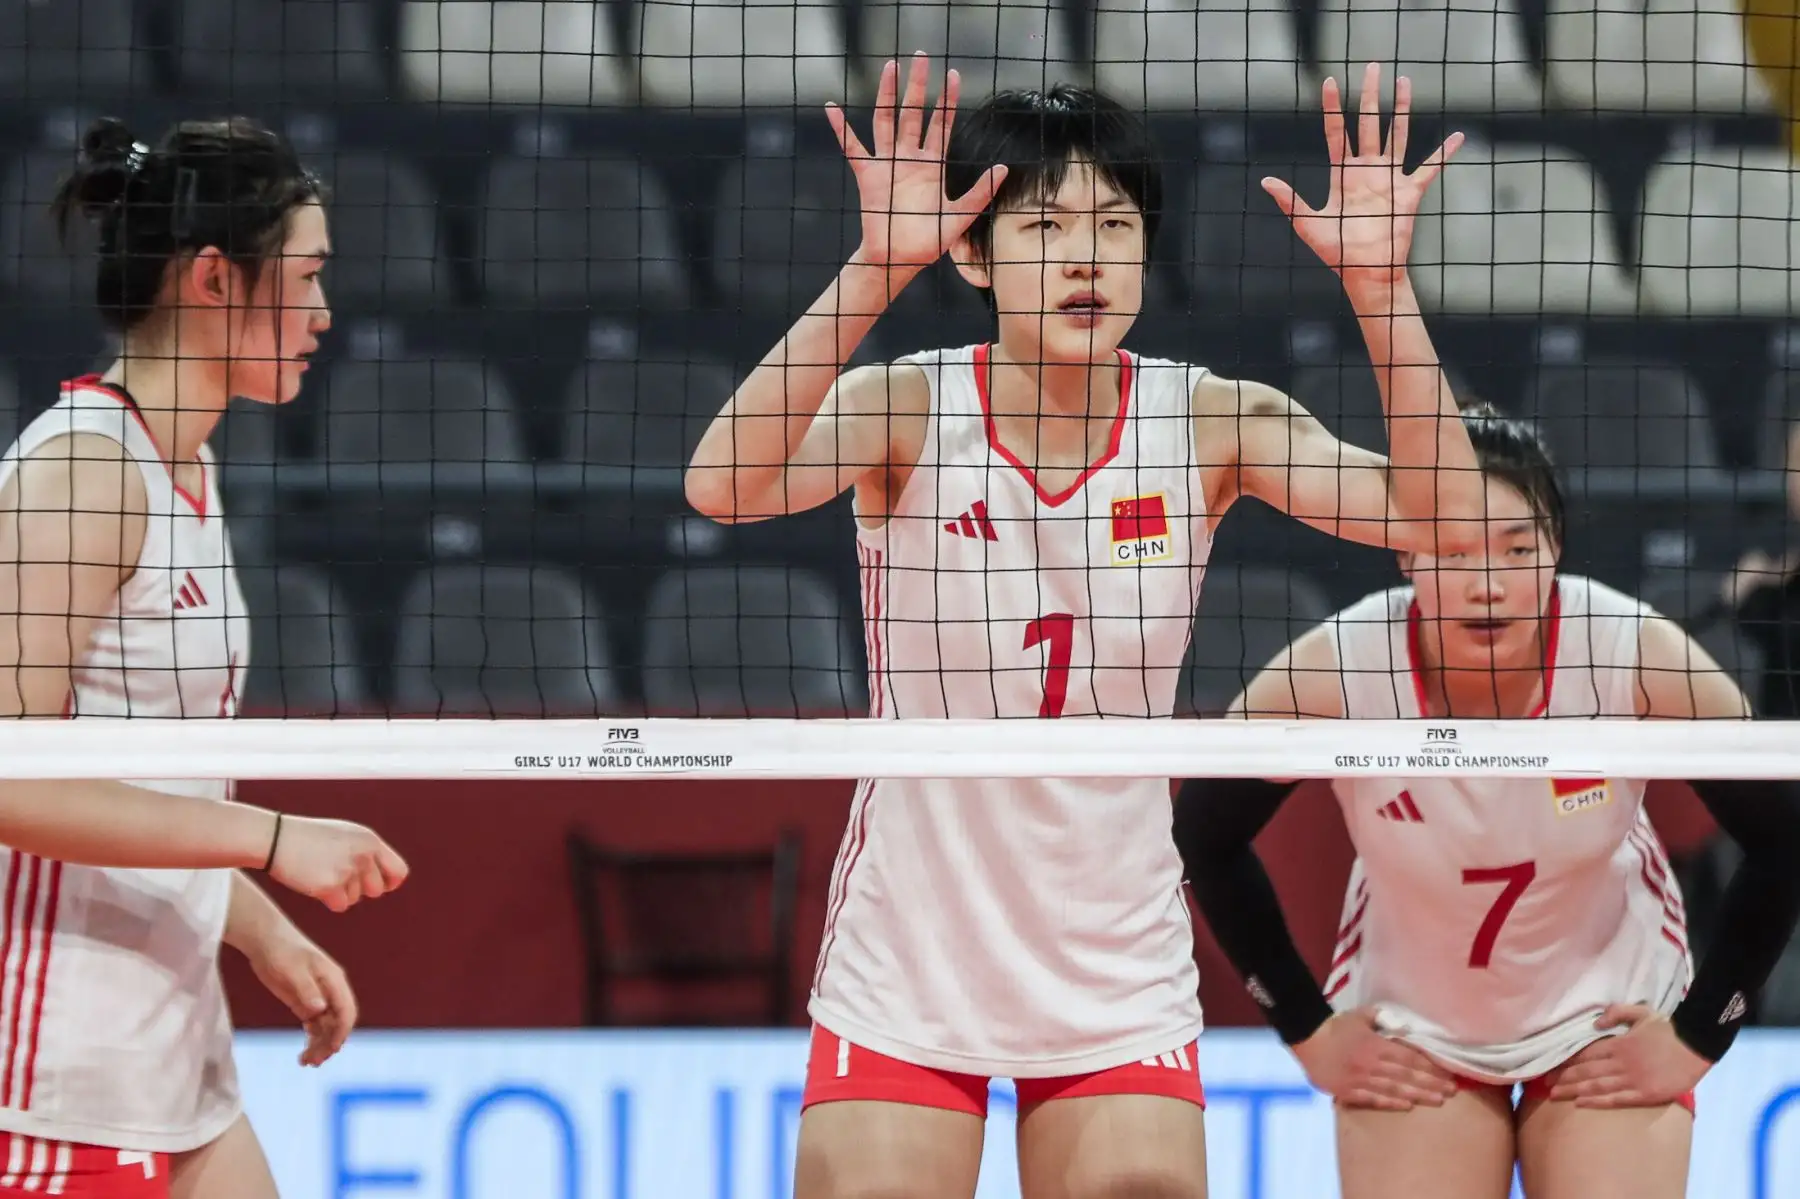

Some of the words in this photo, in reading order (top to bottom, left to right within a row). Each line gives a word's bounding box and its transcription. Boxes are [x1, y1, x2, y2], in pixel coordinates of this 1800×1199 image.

[1118, 540, 1164, 560] CHN
[1022, 612, 1074, 718] 1
[558, 756, 582, 768] U17
[587, 756, 632, 768] WORLD
[636, 755, 734, 768] CHAMPIONSHIP
[1377, 756, 1401, 768] U17
[1406, 756, 1450, 768] WORLD
[1454, 756, 1550, 768] CHAMPIONSHIP
[1562, 790, 1604, 811] CHN
[1461, 861, 1536, 969] 7
